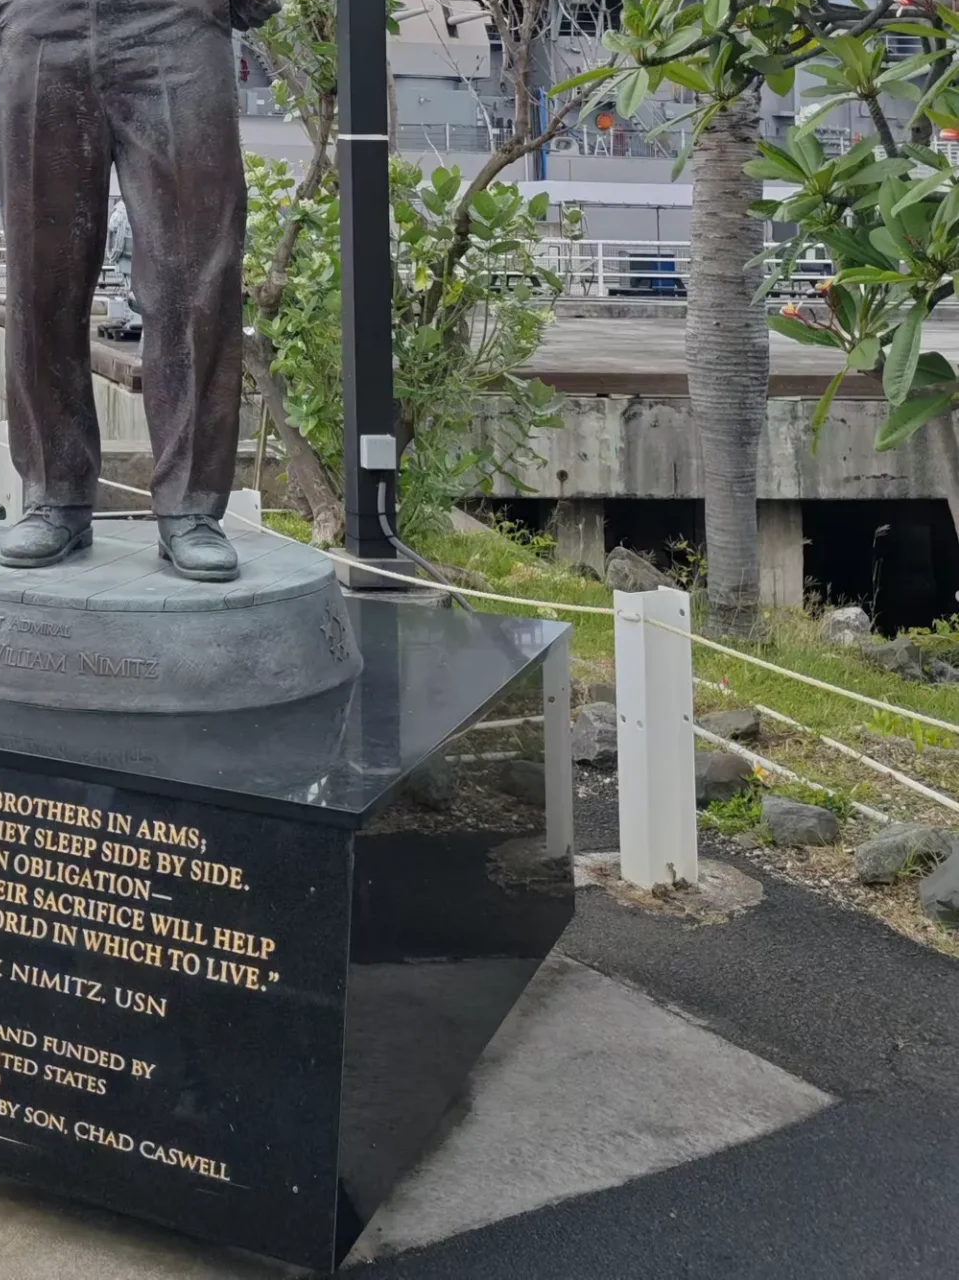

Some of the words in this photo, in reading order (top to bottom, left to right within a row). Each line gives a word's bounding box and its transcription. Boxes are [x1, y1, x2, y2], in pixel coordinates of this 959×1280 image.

[8, 616, 72, 639] ADMIRAL
[34, 827, 98, 858] SLEEP
[102, 842, 152, 870] SIDE
[157, 853, 187, 880] BY
[190, 860, 250, 891] SIDE.
[107, 812, 132, 833] IN
[136, 819, 207, 853] ARMS;
[33, 888, 145, 932] SACRIFICE
[150, 912, 208, 947] WILL
[213, 926, 276, 960] HELP
[52, 922, 77, 947] IN
[82, 929, 162, 967] WHICH
[167, 949, 201, 975] TO
[10, 962, 107, 1004] NIMITZ,
[114, 987, 168, 1018] USN
[42, 1035, 125, 1071] FUNDED
[131, 1059, 156, 1080] BY
[43, 1064, 107, 1095] STATES
[24, 1107, 68, 1135] SON,
[74, 1121, 134, 1151] CHAD
[140, 1140, 230, 1181] CASWELL
